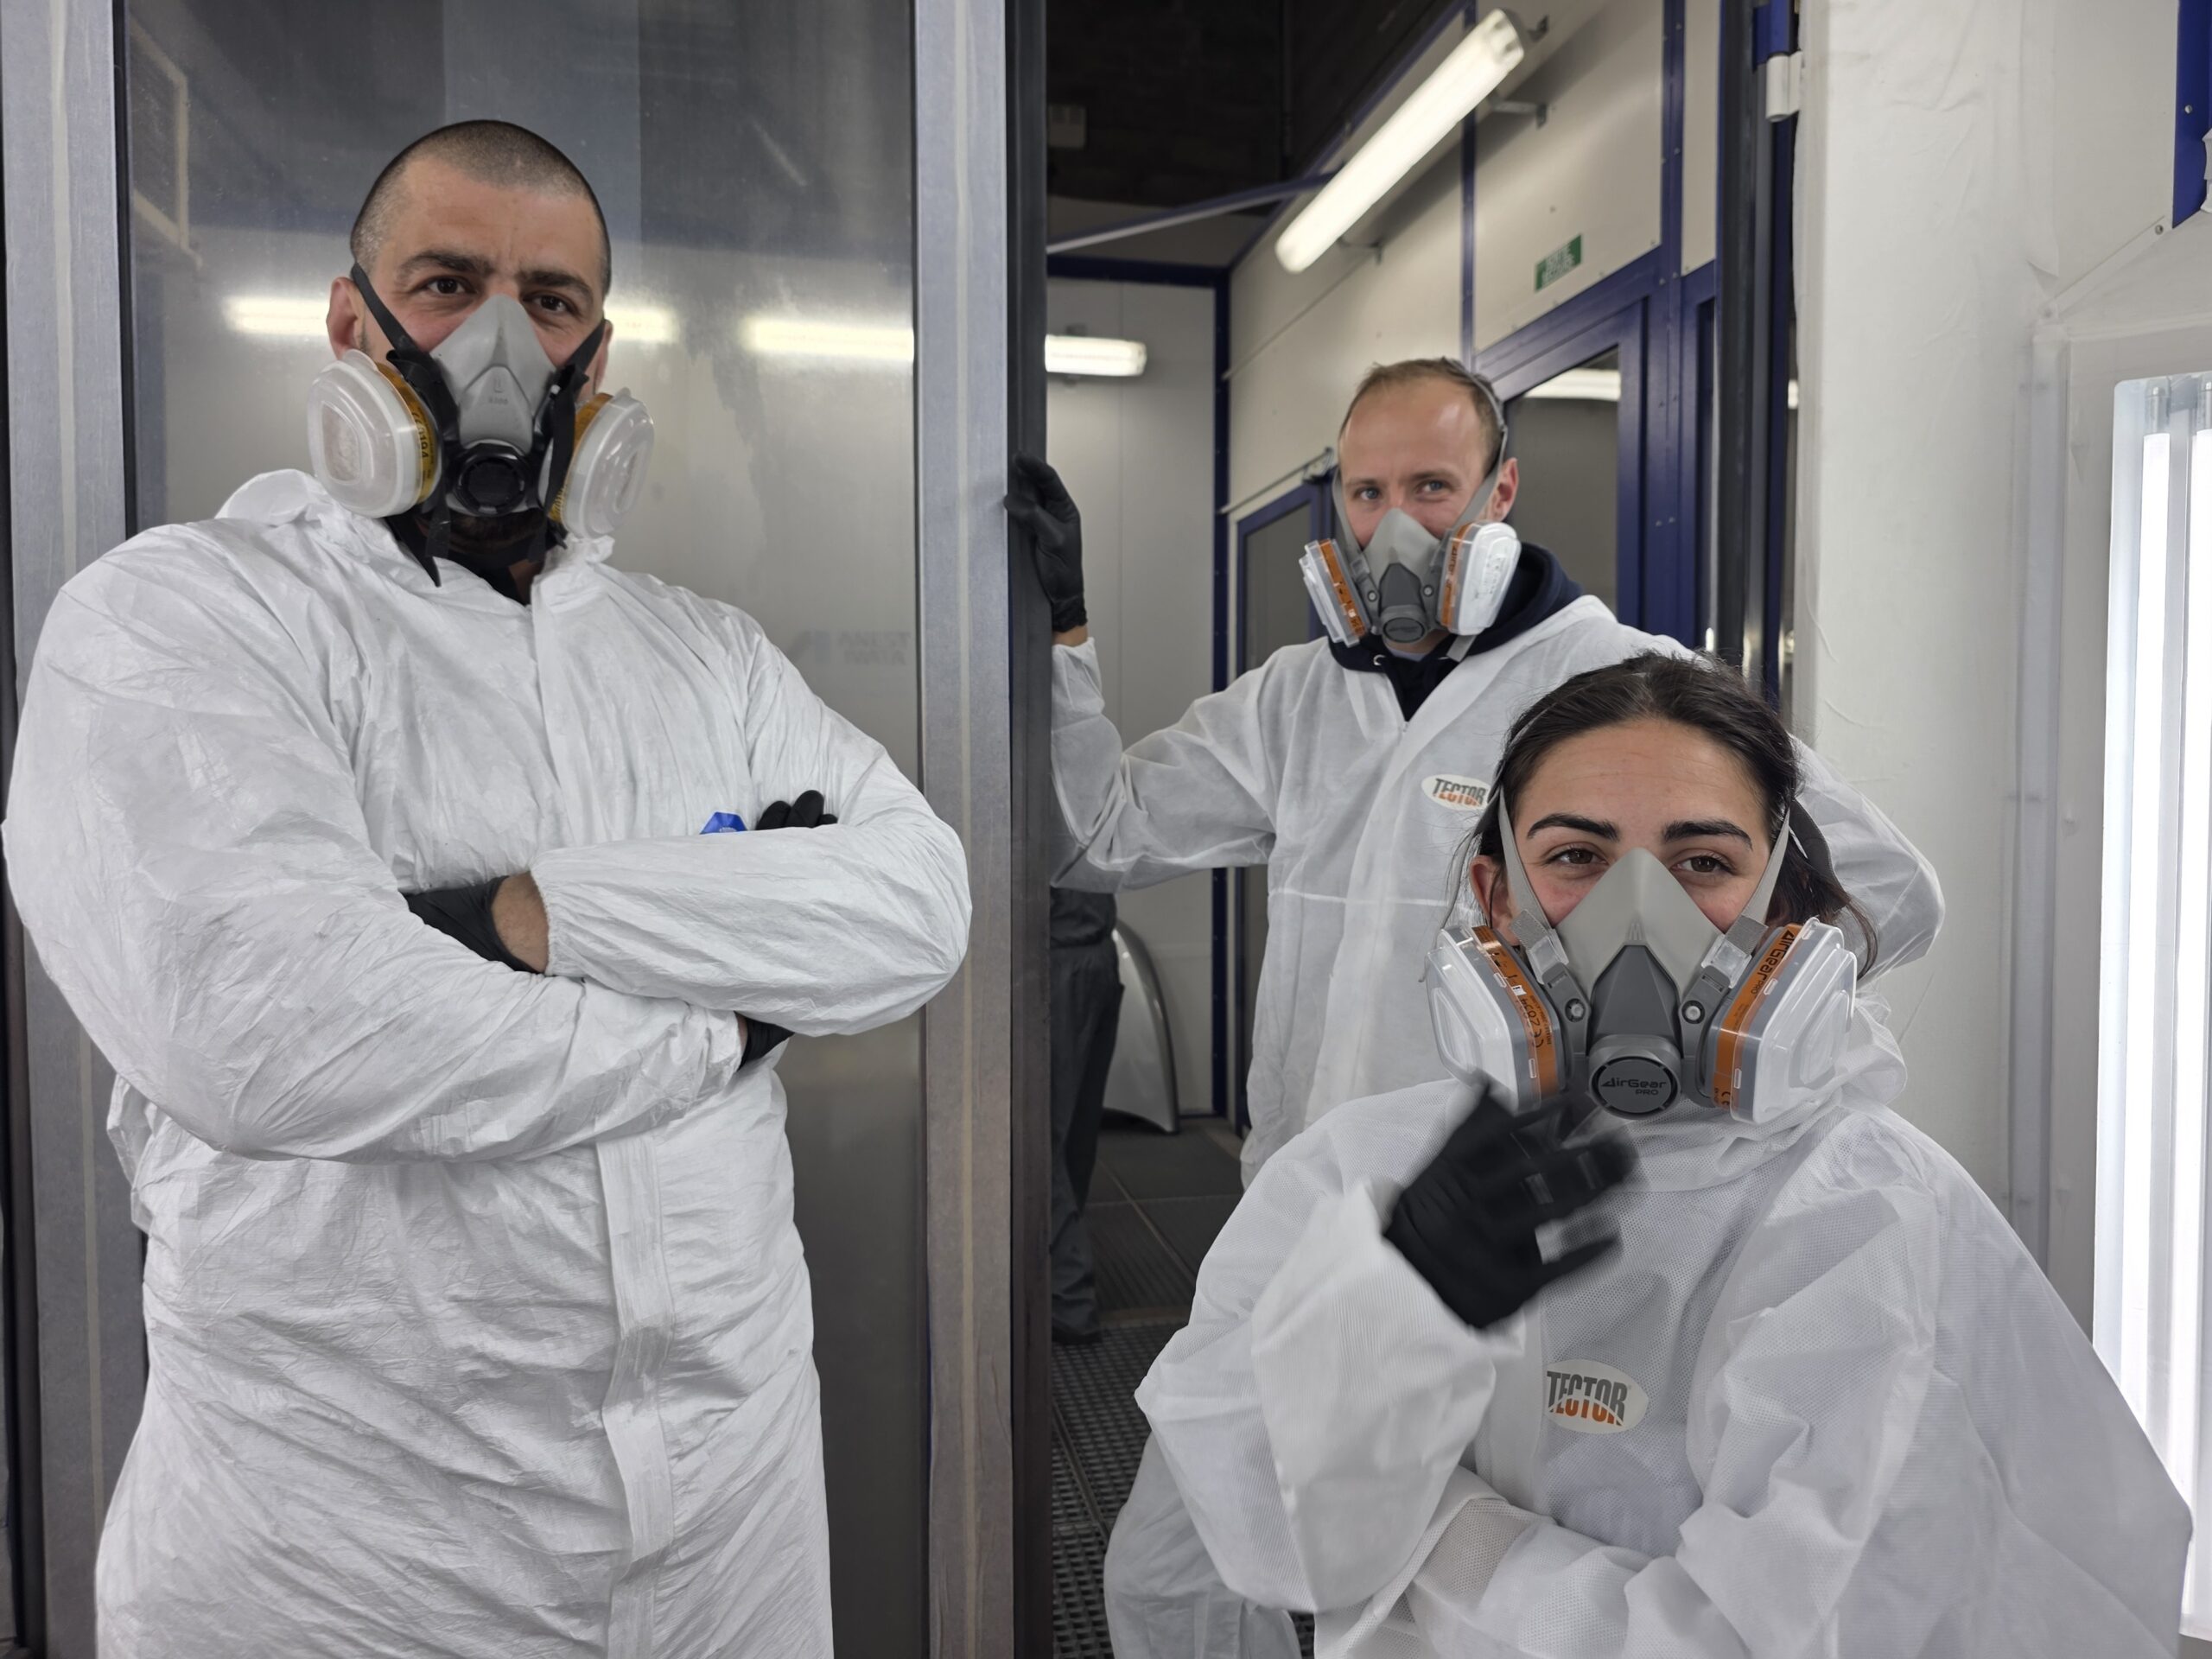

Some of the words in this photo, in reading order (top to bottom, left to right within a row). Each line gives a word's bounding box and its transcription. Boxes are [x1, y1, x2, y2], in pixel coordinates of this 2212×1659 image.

[1433, 778, 1487, 808] TECTOR
[1601, 1077, 1668, 1089] AirGear
[1547, 1370, 1628, 1427] TECTOR
